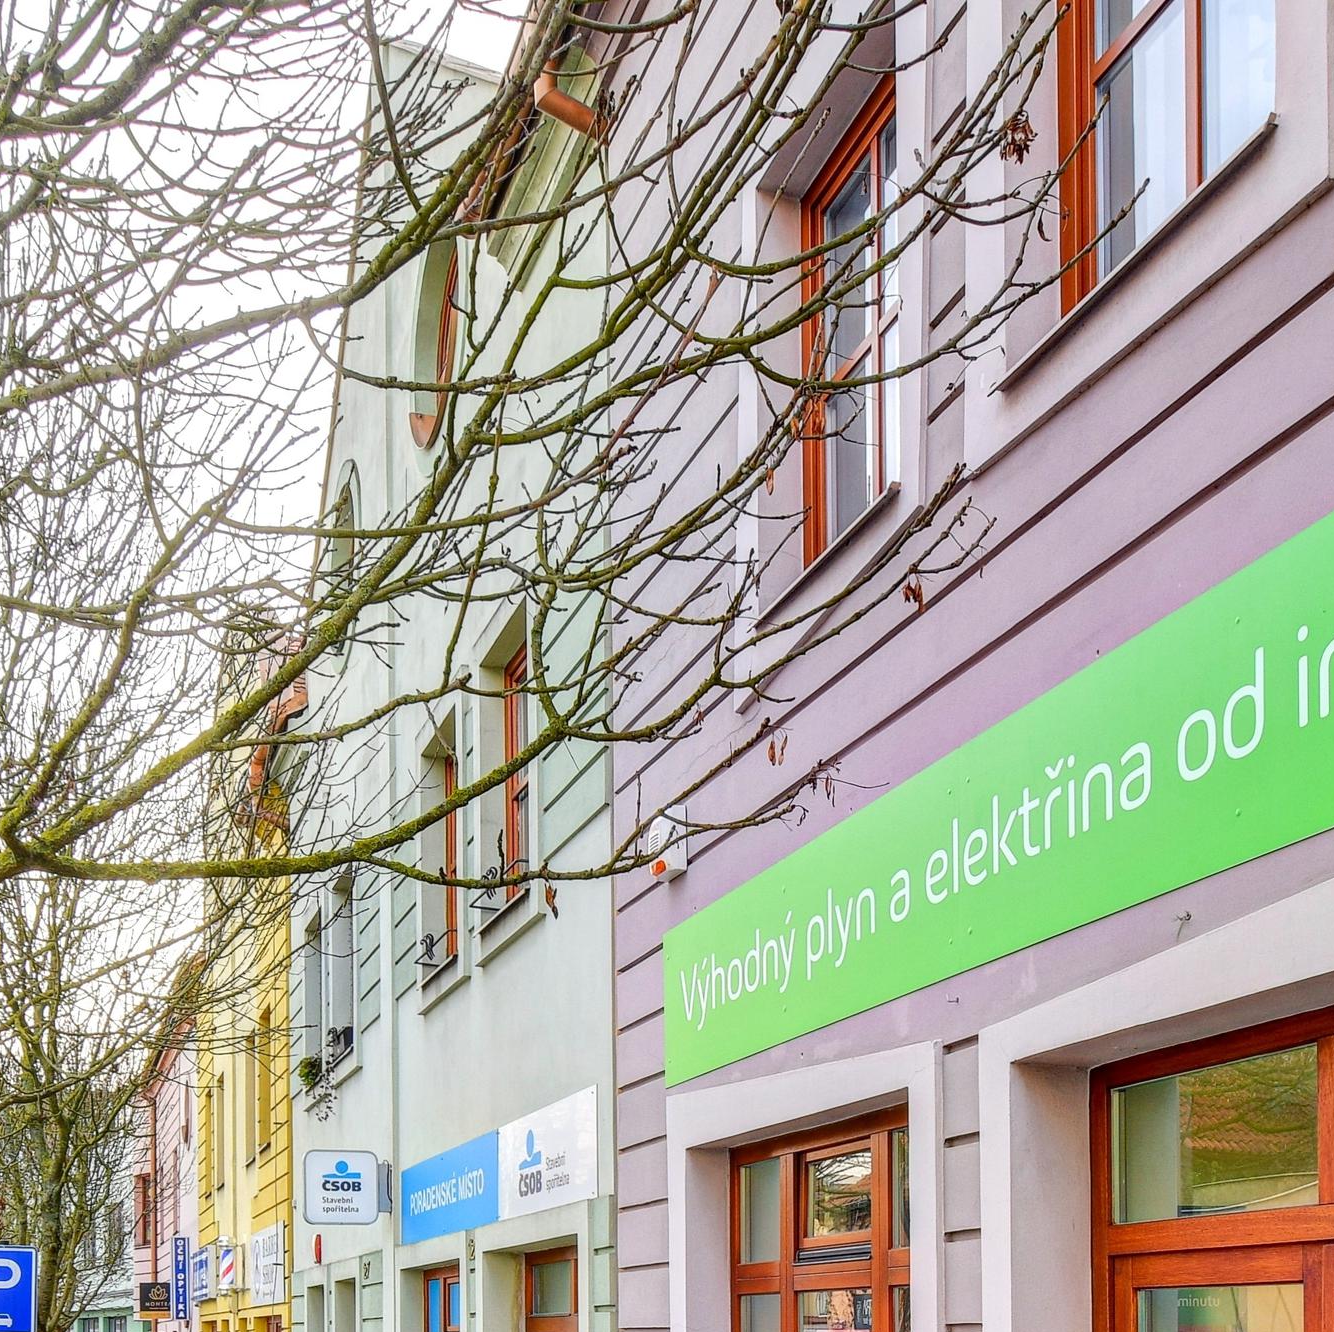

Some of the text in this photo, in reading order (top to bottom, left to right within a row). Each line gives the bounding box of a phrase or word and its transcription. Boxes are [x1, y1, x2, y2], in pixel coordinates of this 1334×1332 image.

[680, 910, 796, 1031] Výhodný
[806, 886, 876, 981] plyn
[889, 868, 911, 922] a
[925, 741, 1153, 904] elektřina
[1177, 645, 1265, 782] od
[321, 1180, 362, 1192] ČSOB
[410, 1165, 485, 1217] PORADENSKÉ MÍSTO
[519, 1169, 543, 1198] ČSOB
[322, 1196, 354, 1204] Stavební
[322, 1205, 360, 1214] spořitelna
[176, 1239, 186, 1318] OČNÍ OPTIKA
